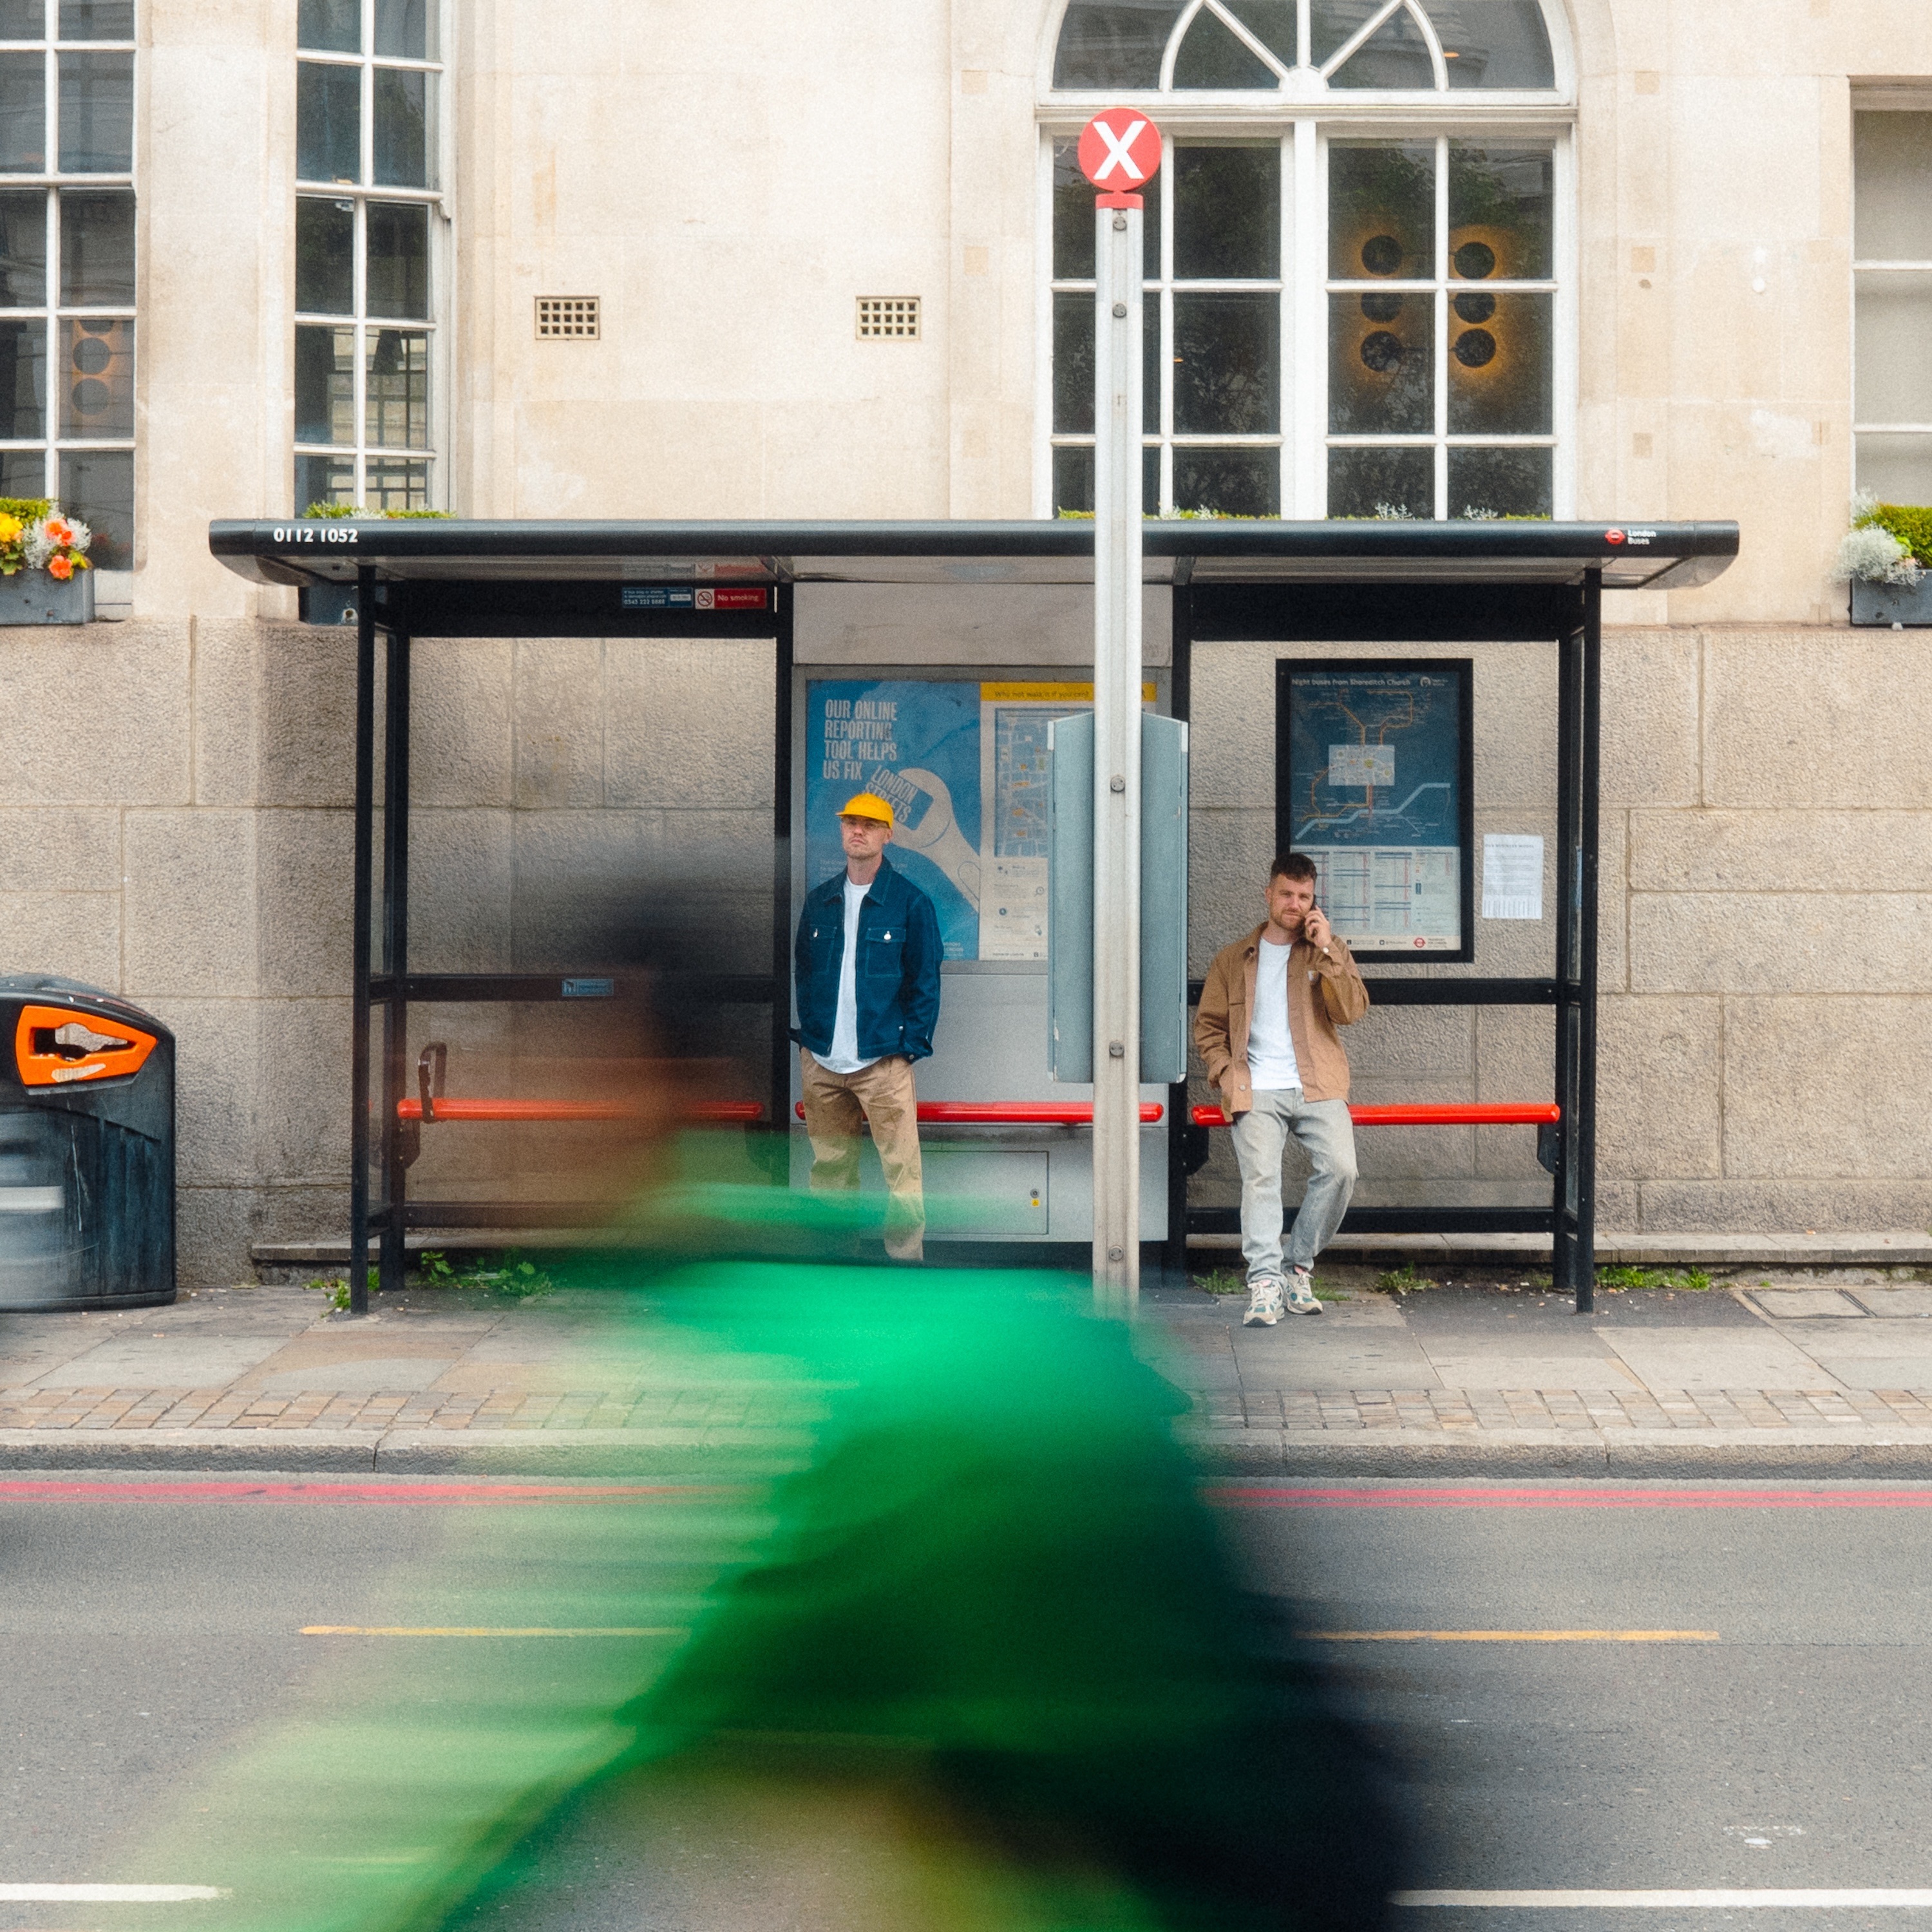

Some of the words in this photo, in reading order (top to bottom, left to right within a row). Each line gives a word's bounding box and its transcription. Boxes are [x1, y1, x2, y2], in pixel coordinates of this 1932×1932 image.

[1092, 120, 1147, 180] X
[273, 527, 314, 543] 0112
[321, 527, 359, 543] 1052
[1627, 529, 1657, 537] London
[730, 594, 759, 602] smoking
[825, 699, 851, 719] OUR
[855, 701, 898, 721] ONLINE
[824, 719, 892, 741] REPORTING
[824, 739, 853, 760] TOOL
[858, 741, 898, 761] HELPS
[822, 760, 840, 780] US
[844, 761, 863, 781] FIX
[870, 764, 918, 805] LONDON
